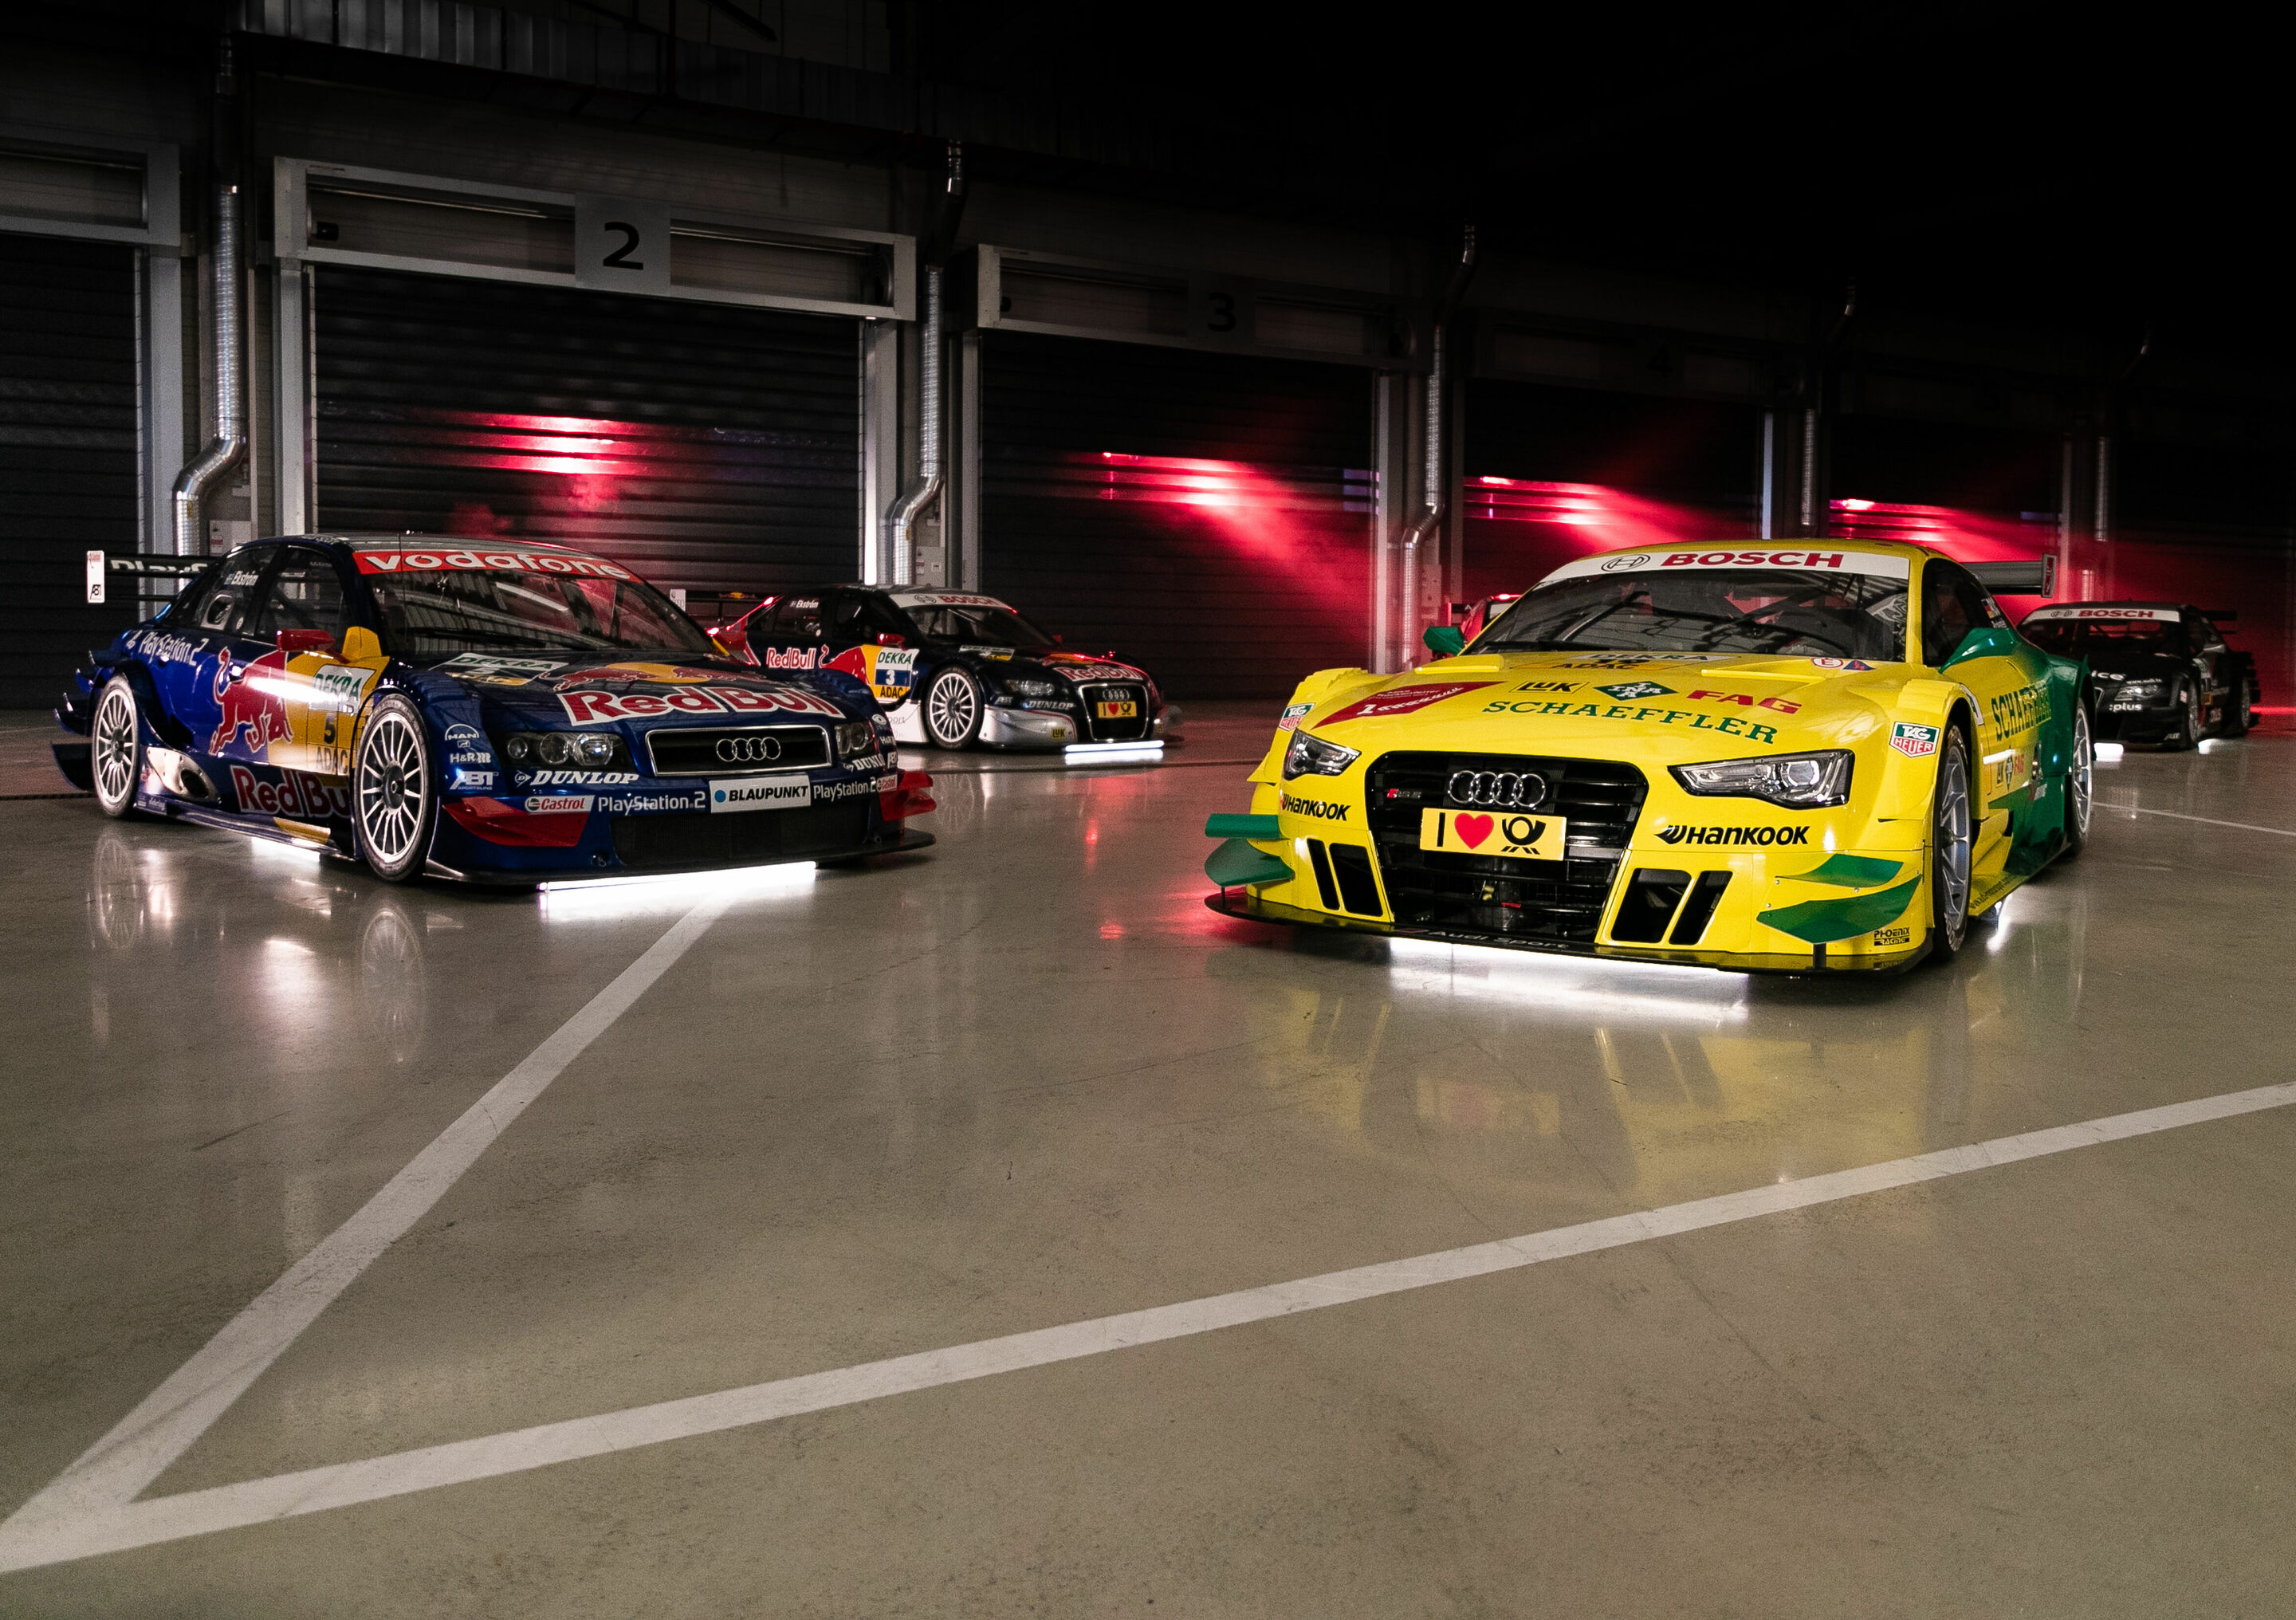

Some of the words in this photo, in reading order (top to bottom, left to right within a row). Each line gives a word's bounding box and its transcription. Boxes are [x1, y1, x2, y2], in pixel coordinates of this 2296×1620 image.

[603, 222, 643, 270] 2
[1207, 292, 1236, 332] 3
[365, 551, 631, 580] vodafone
[1661, 552, 1844, 568] BOSCH
[938, 595, 997, 606] BOSCH
[2078, 609, 2154, 619] BOSCH
[766, 647, 791, 669] Red
[790, 647, 816, 669] Bull
[877, 651, 912, 665] DEKRA
[885, 670, 895, 685] 3
[1053, 665, 1103, 682] Red
[1102, 666, 1143, 681] Bull
[879, 685, 904, 698] ADAC
[557, 686, 729, 726] Red
[706, 686, 847, 719] Bull
[994, 696, 1014, 705] ABT
[1028, 700, 1075, 710] DUNLOP
[1686, 689, 1803, 714] FAG
[1482, 701, 1778, 744] SCHAEFFLER
[1902, 725, 1931, 741] TAG
[1894, 737, 1932, 754] HEUER
[316, 746, 348, 774] ADAC
[529, 770, 639, 786] DUNLOP
[230, 765, 305, 817] Red
[297, 771, 352, 819] Bu
[729, 785, 809, 802] BLAUPUNKT
[541, 797, 586, 811] Castrol
[598, 795, 690, 816] PlayStation
[1436, 812, 1446, 847] I
[1428, 930, 1489, 941] Audi
[1492, 937, 1570, 949] Sport
